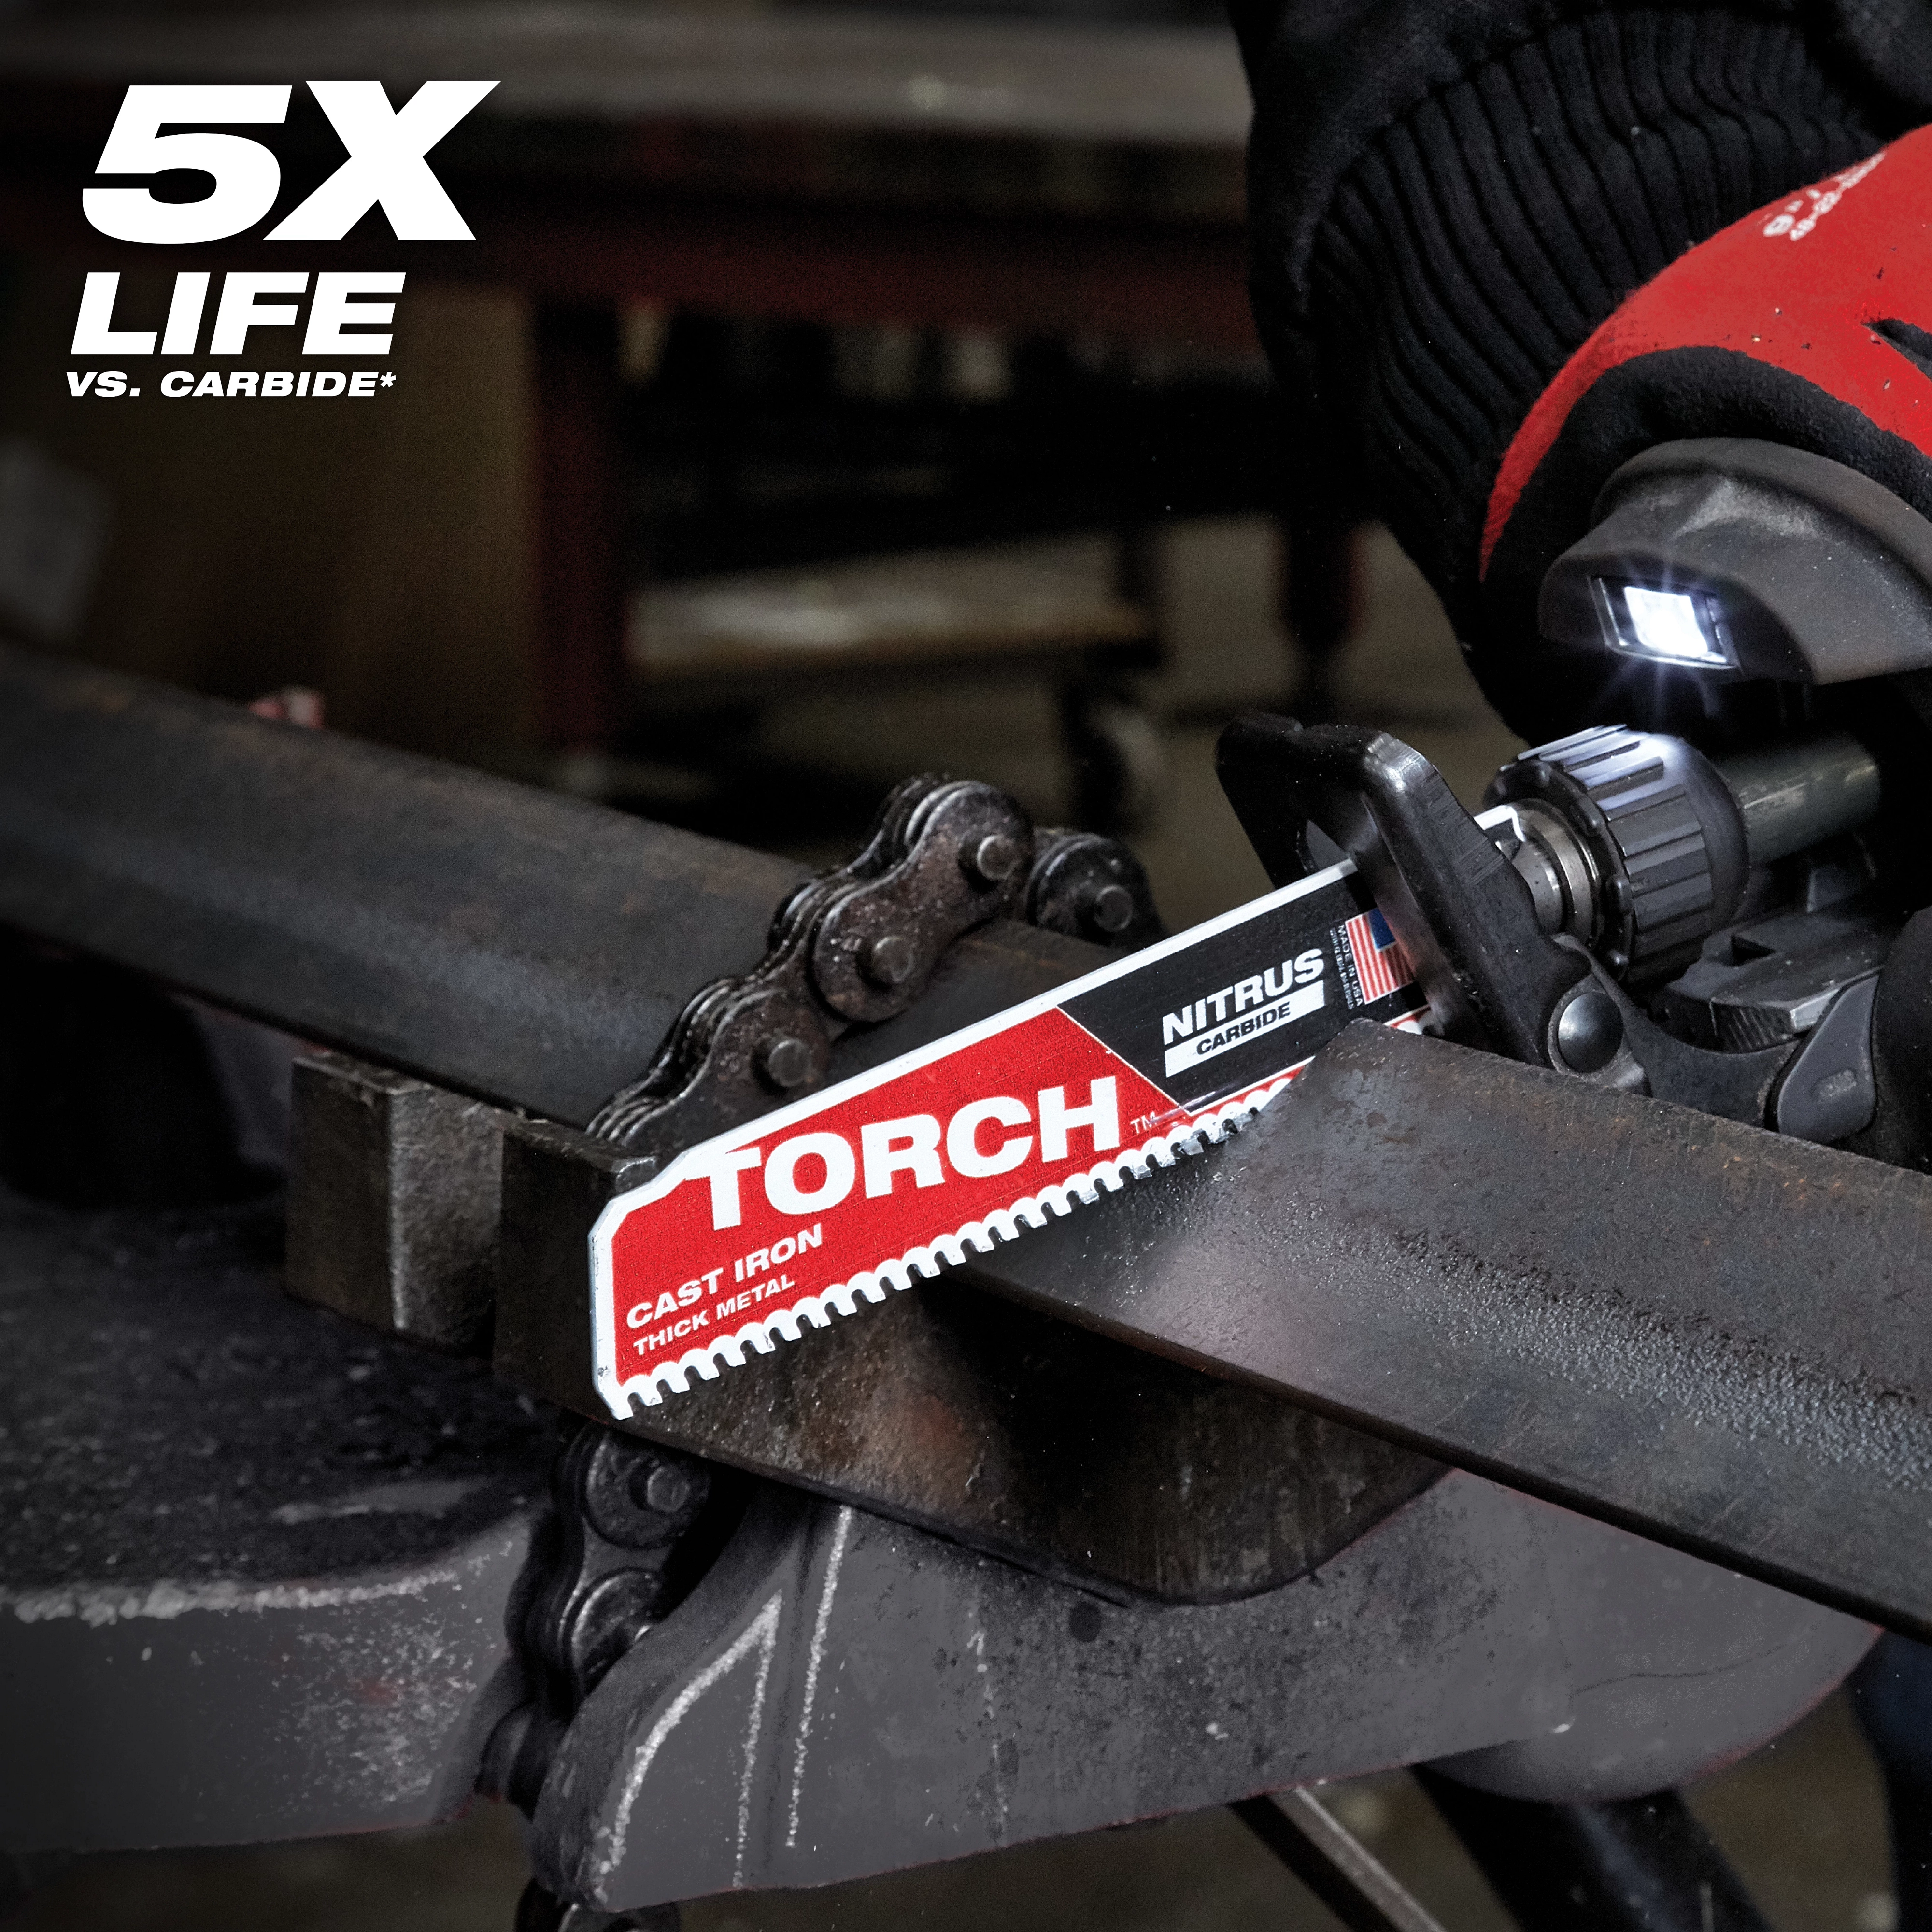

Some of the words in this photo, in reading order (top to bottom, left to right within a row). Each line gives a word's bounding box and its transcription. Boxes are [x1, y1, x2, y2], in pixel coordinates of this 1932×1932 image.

[1163, 948, 1324, 1045] NITRUS
[1338, 924, 1352, 962] MADE
[1348, 964, 1355, 977] IN
[1352, 980, 1363, 1007] USA
[1196, 1001, 1290, 1055] CARBIDE
[686, 1076, 1121, 1231] TORCH
[1130, 1111, 1156, 1134] TM
[627, 1268, 724, 1329] CAST
[734, 1223, 822, 1283] IRON
[633, 1310, 709, 1355] THICK
[716, 1275, 796, 1320] METAL
